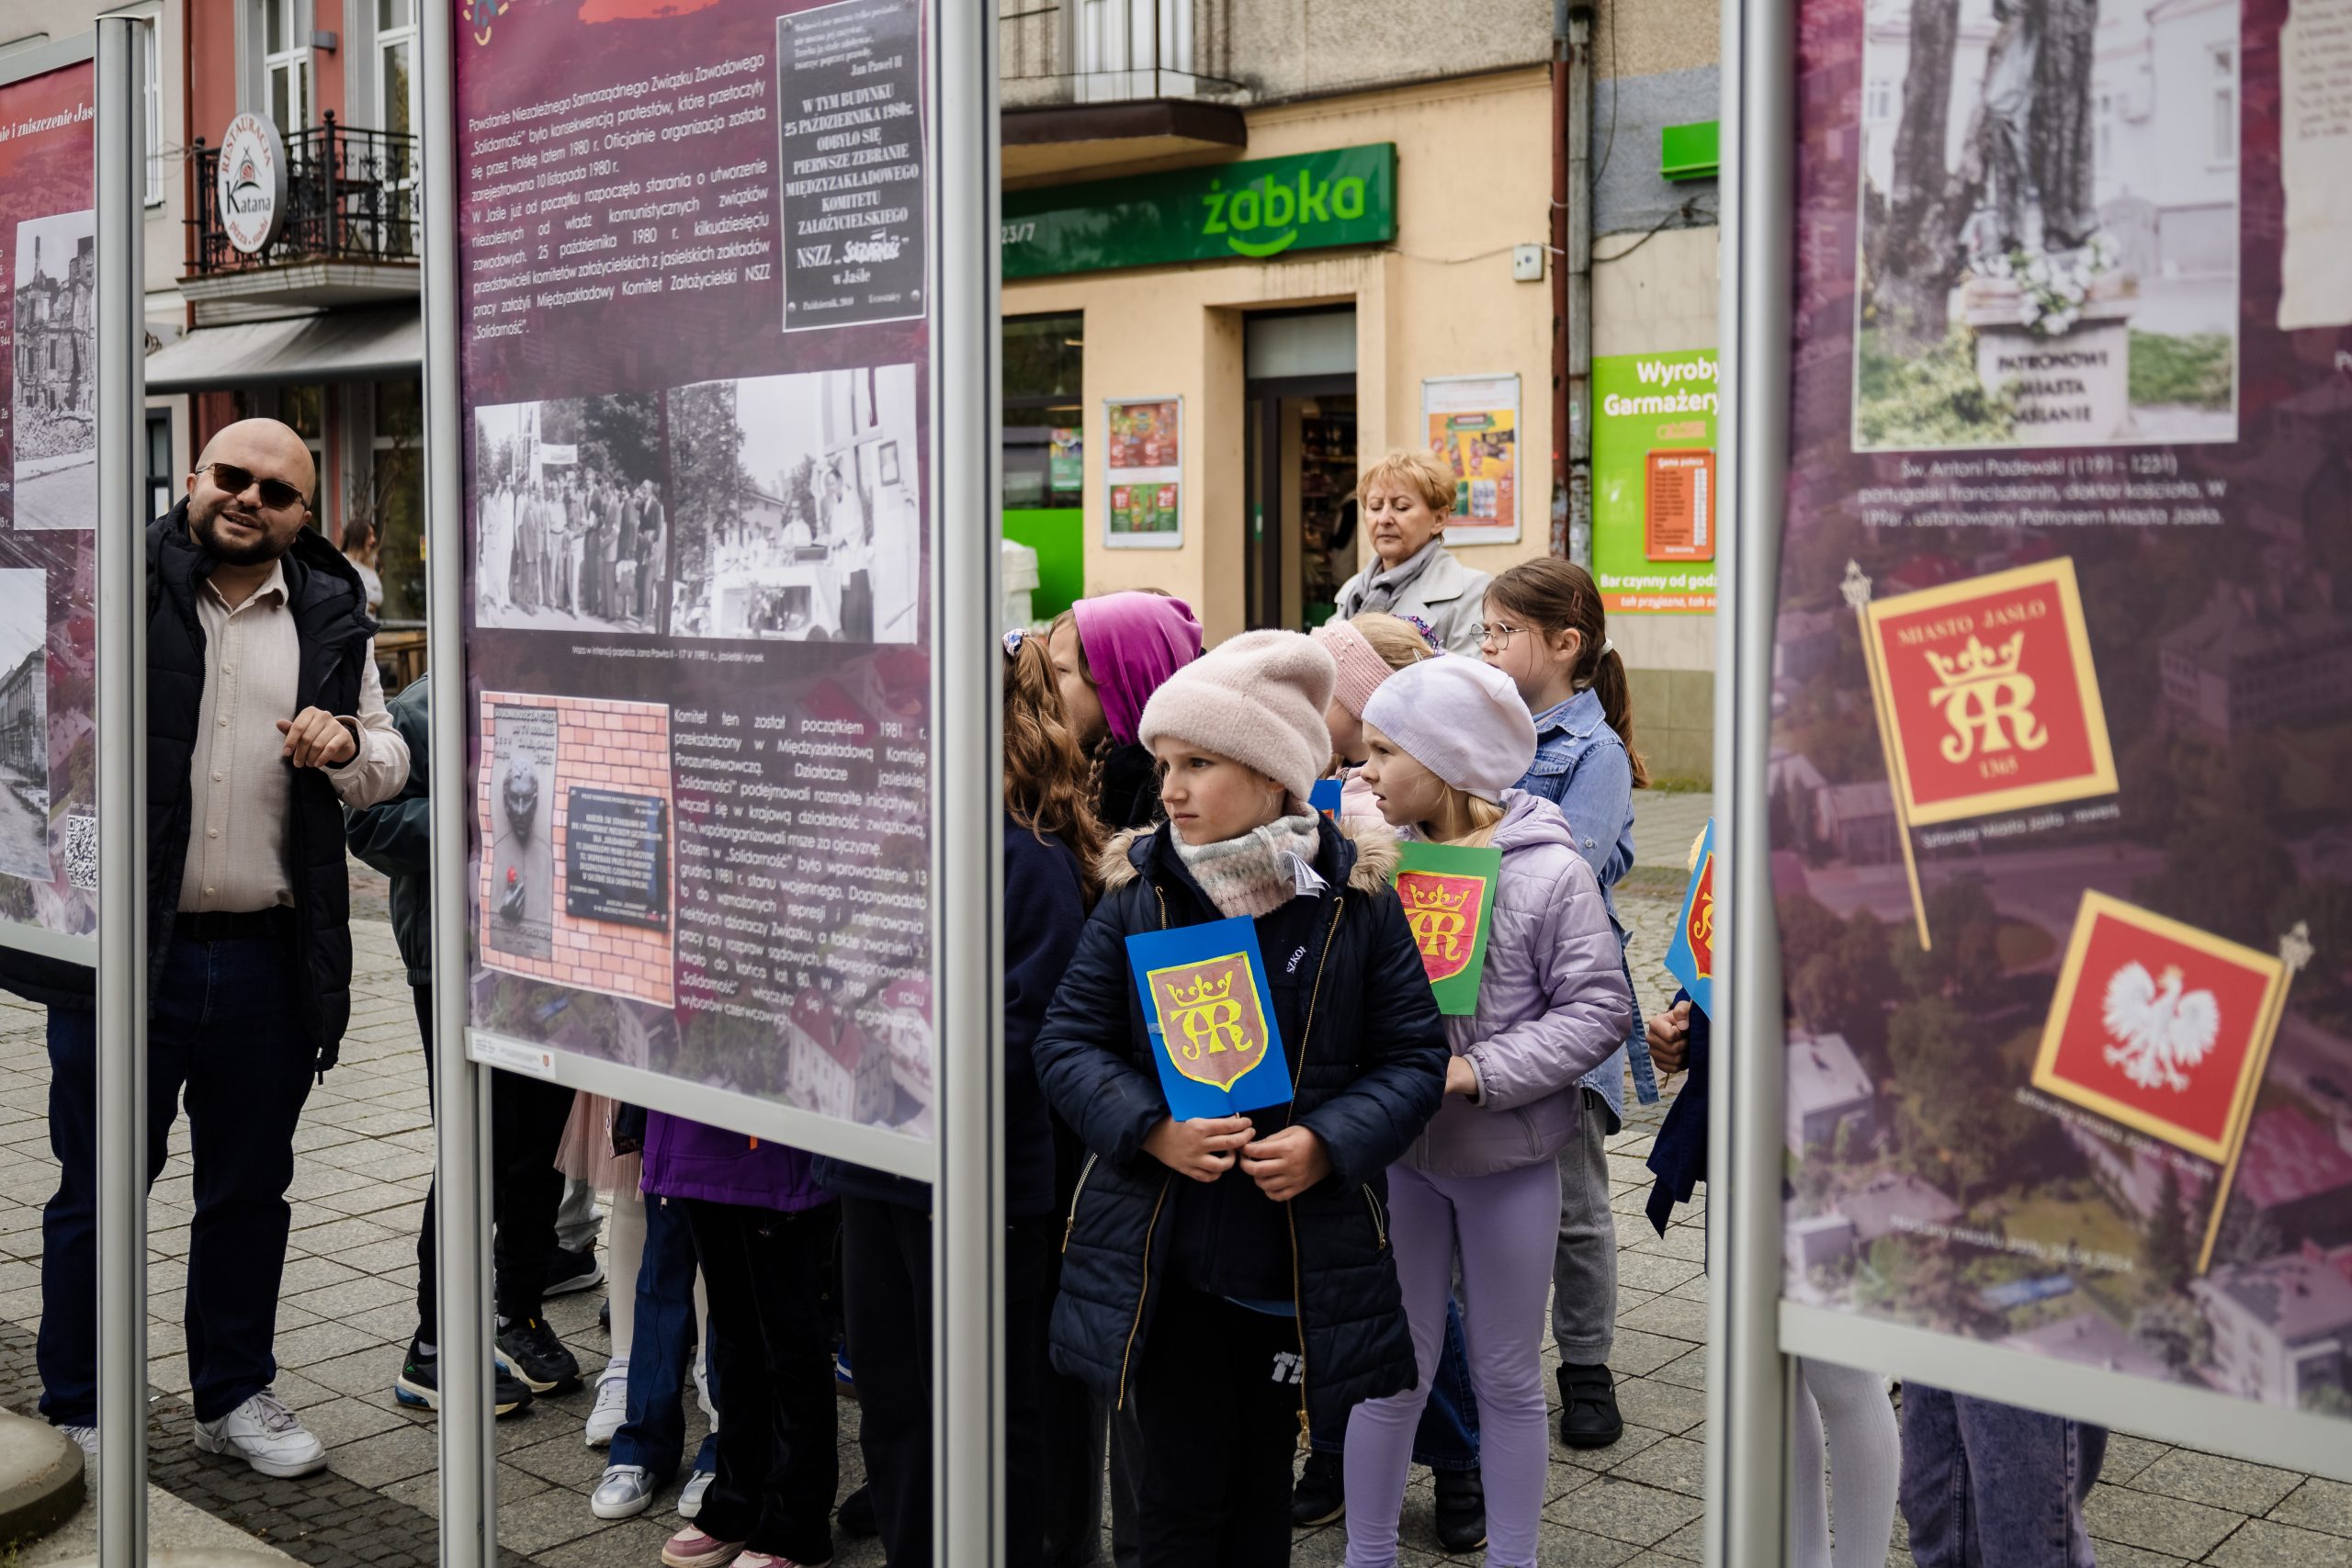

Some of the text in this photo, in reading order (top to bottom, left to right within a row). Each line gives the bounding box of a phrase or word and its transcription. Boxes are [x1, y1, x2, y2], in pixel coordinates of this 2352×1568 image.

[469, 111, 511, 132] Powstanie
[571, 81, 649, 108] Samorządnego
[651, 71, 694, 92] Związku
[695, 53, 765, 83] Zawodowego
[221, 117, 270, 173] RESTAURACJA
[570, 140, 590, 157] 1980
[604, 128, 656, 150] Oficjalnie
[661, 115, 725, 142] organizacja
[729, 106, 766, 127] została
[589, 160, 611, 176] 1980
[646, 173, 691, 193] starania
[710, 158, 768, 182] utworzenie
[225, 180, 270, 214] Katana
[1202, 168, 1365, 234] żabka
[538, 220, 550, 236] od
[632, 227, 658, 244] 1980
[622, 276, 663, 296] Komitet
[745, 264, 771, 282] NSZZ
[1600, 573, 1686, 590] Bar czynny od
